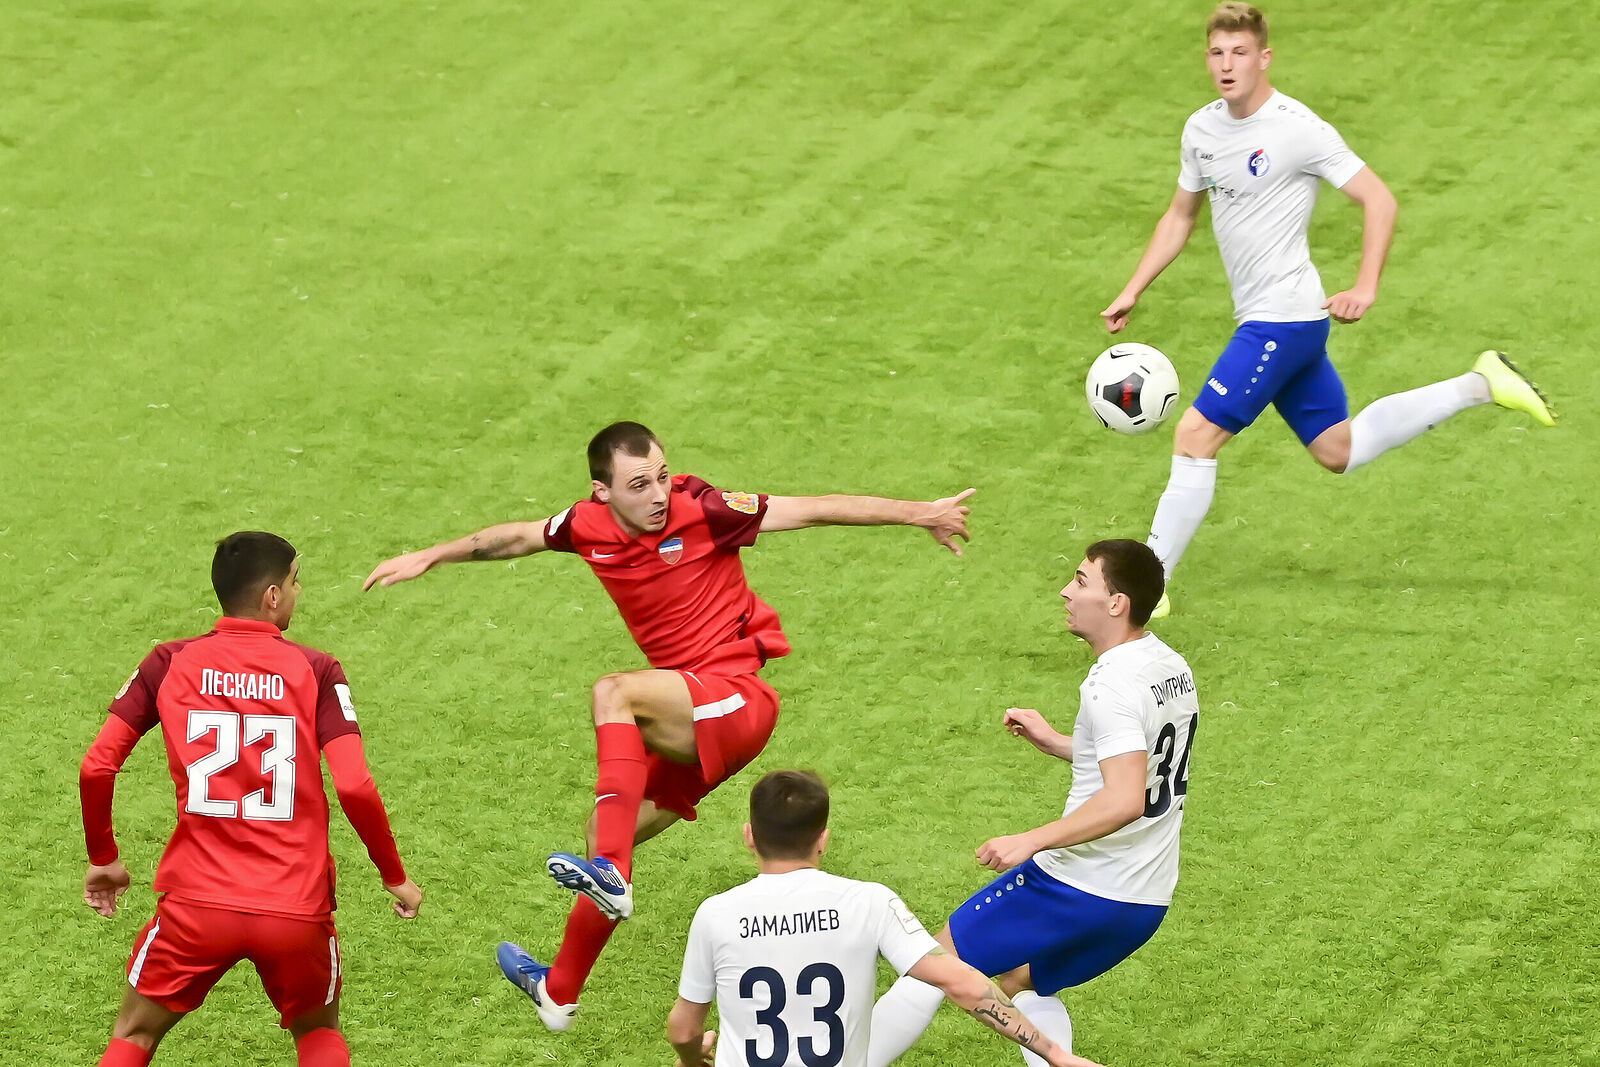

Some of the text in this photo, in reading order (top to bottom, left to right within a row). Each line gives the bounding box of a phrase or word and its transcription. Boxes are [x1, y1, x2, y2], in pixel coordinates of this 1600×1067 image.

[1208, 377, 1229, 396] JAKO
[200, 668, 284, 700] ЛЕСКАНО
[185, 710, 296, 821] 23
[1143, 712, 1199, 818] 34
[739, 909, 840, 938] ЗАМАЛИЕВ
[738, 962, 845, 1067] 33
